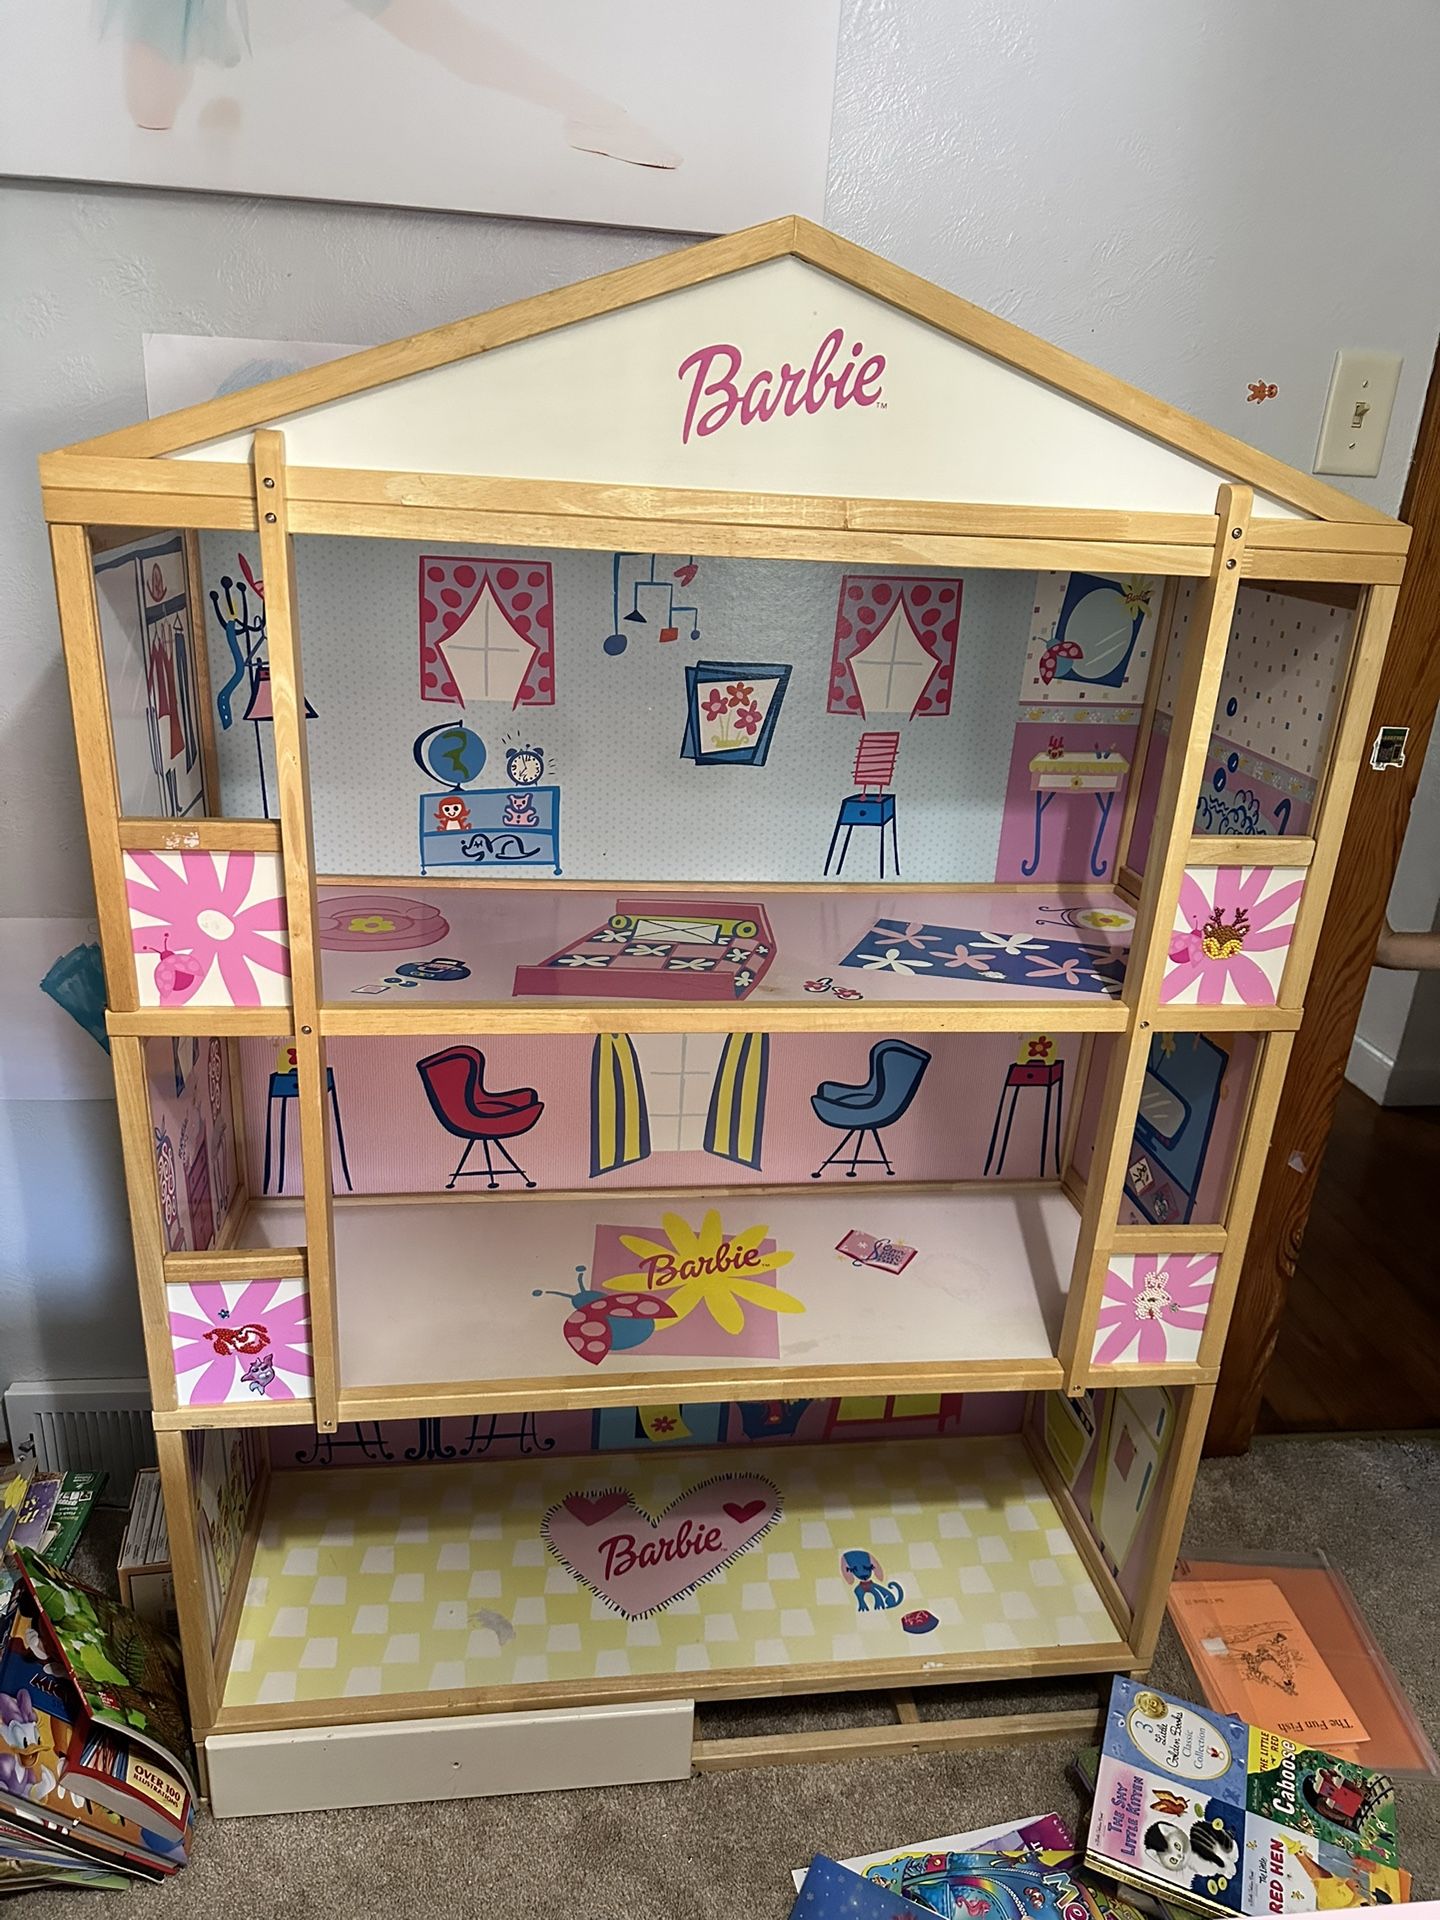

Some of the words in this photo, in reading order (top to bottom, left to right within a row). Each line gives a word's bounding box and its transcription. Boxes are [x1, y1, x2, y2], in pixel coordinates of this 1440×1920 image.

[678, 328, 887, 444] Barbie
[638, 1243, 761, 1290] Barbie
[598, 1520, 722, 1581] Barbie
[1135, 1721, 1153, 1733] 3
[1155, 1723, 1168, 1745] Little
[1170, 1712, 1183, 1736] Books
[1277, 1721, 1304, 1733] Fish
[1305, 1720, 1329, 1730] Fun
[1329, 1719, 1354, 1728] The
[1166, 1738, 1181, 1767] Golden
[1182, 1730, 1193, 1757] Classic
[1194, 1728, 1207, 1769] Collection
[1260, 1731, 1270, 1756] LITTLE
[1270, 1735, 1279, 1753] RED
[1260, 1757, 1269, 1772] THE
[1272, 1740, 1296, 1815] Caboose
[133, 1773, 179, 1808] ILLUSTRATIONS
[134, 1765, 164, 1789] OVER
[166, 1784, 181, 1801] 100
[1270, 1838, 1284, 1876] HEN
[1269, 1880, 1284, 1914] RED
